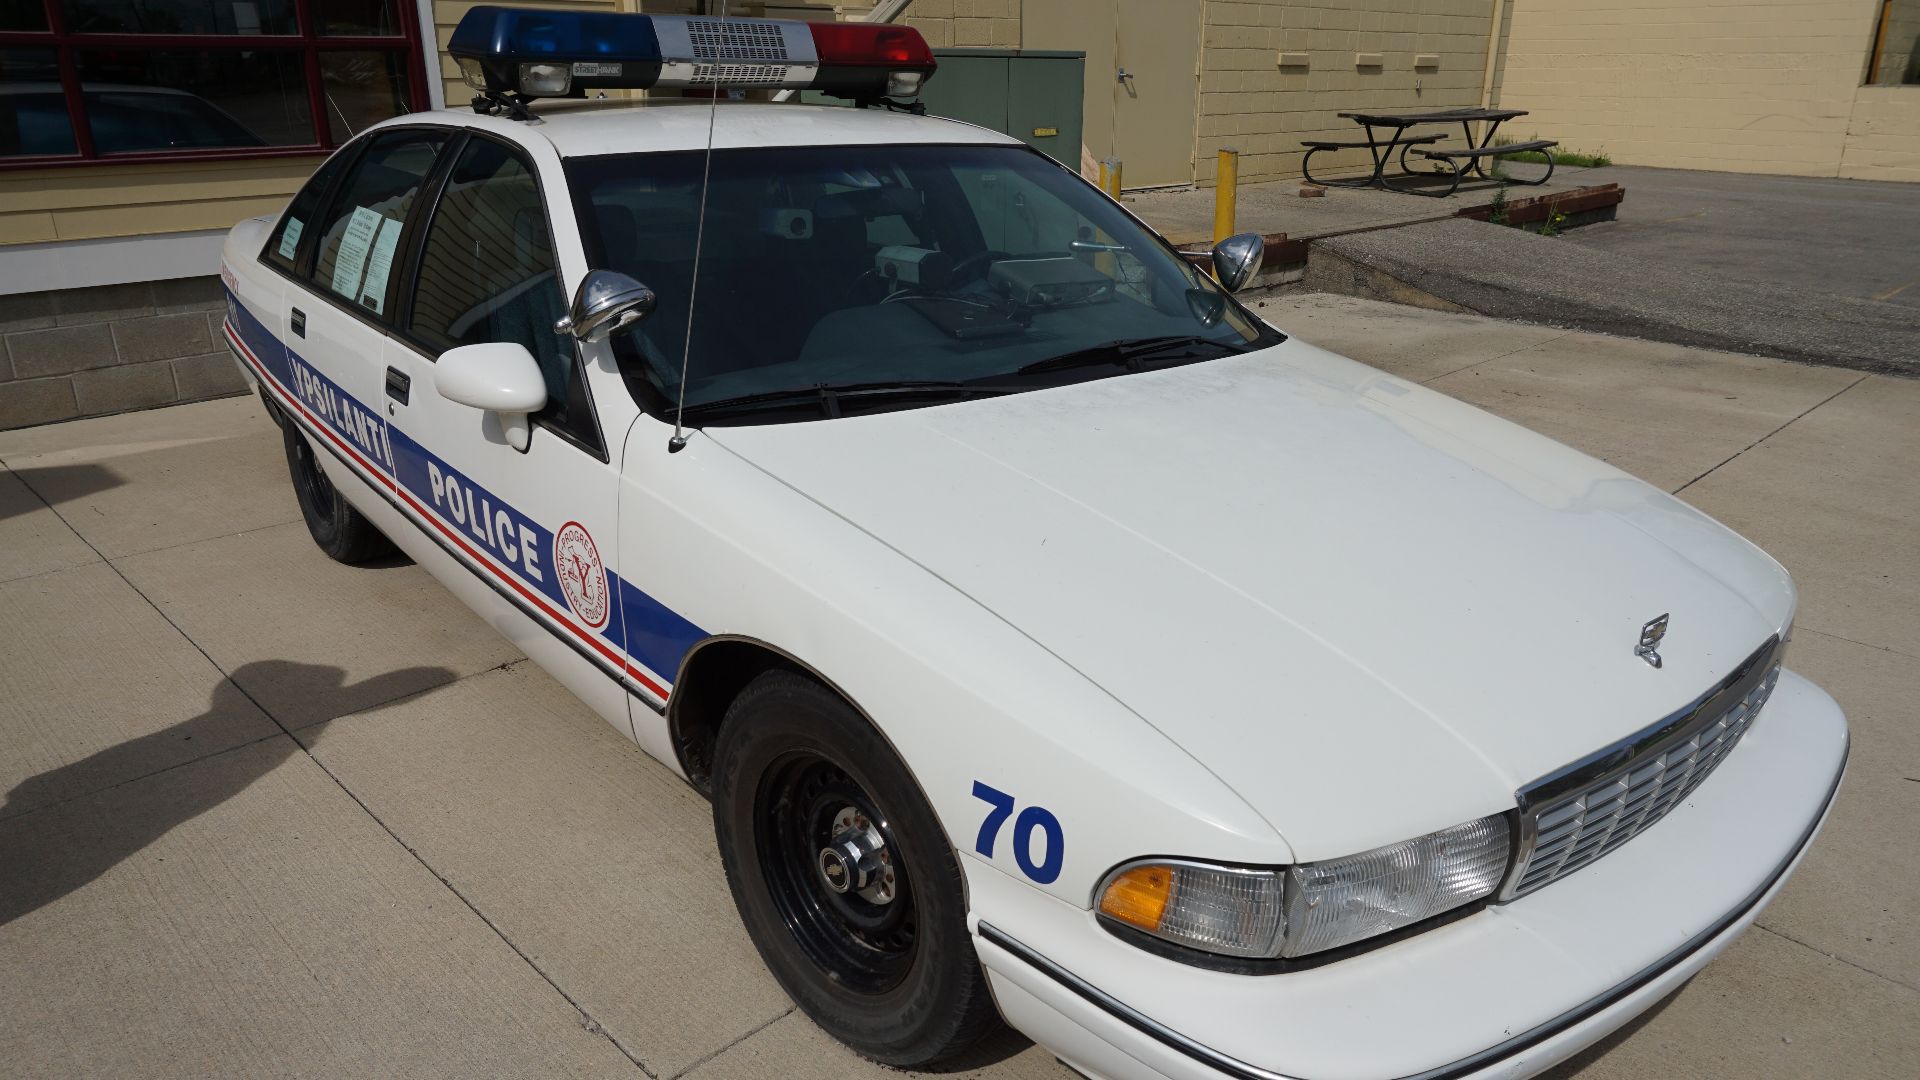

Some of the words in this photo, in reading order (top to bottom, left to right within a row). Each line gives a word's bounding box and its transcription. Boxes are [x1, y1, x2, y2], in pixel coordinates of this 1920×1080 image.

[291, 357, 393, 467] YPSILANTI
[427, 460, 543, 582] POLICE
[561, 530, 598, 567] PROGRESS
[972, 780, 1065, 885] 70
